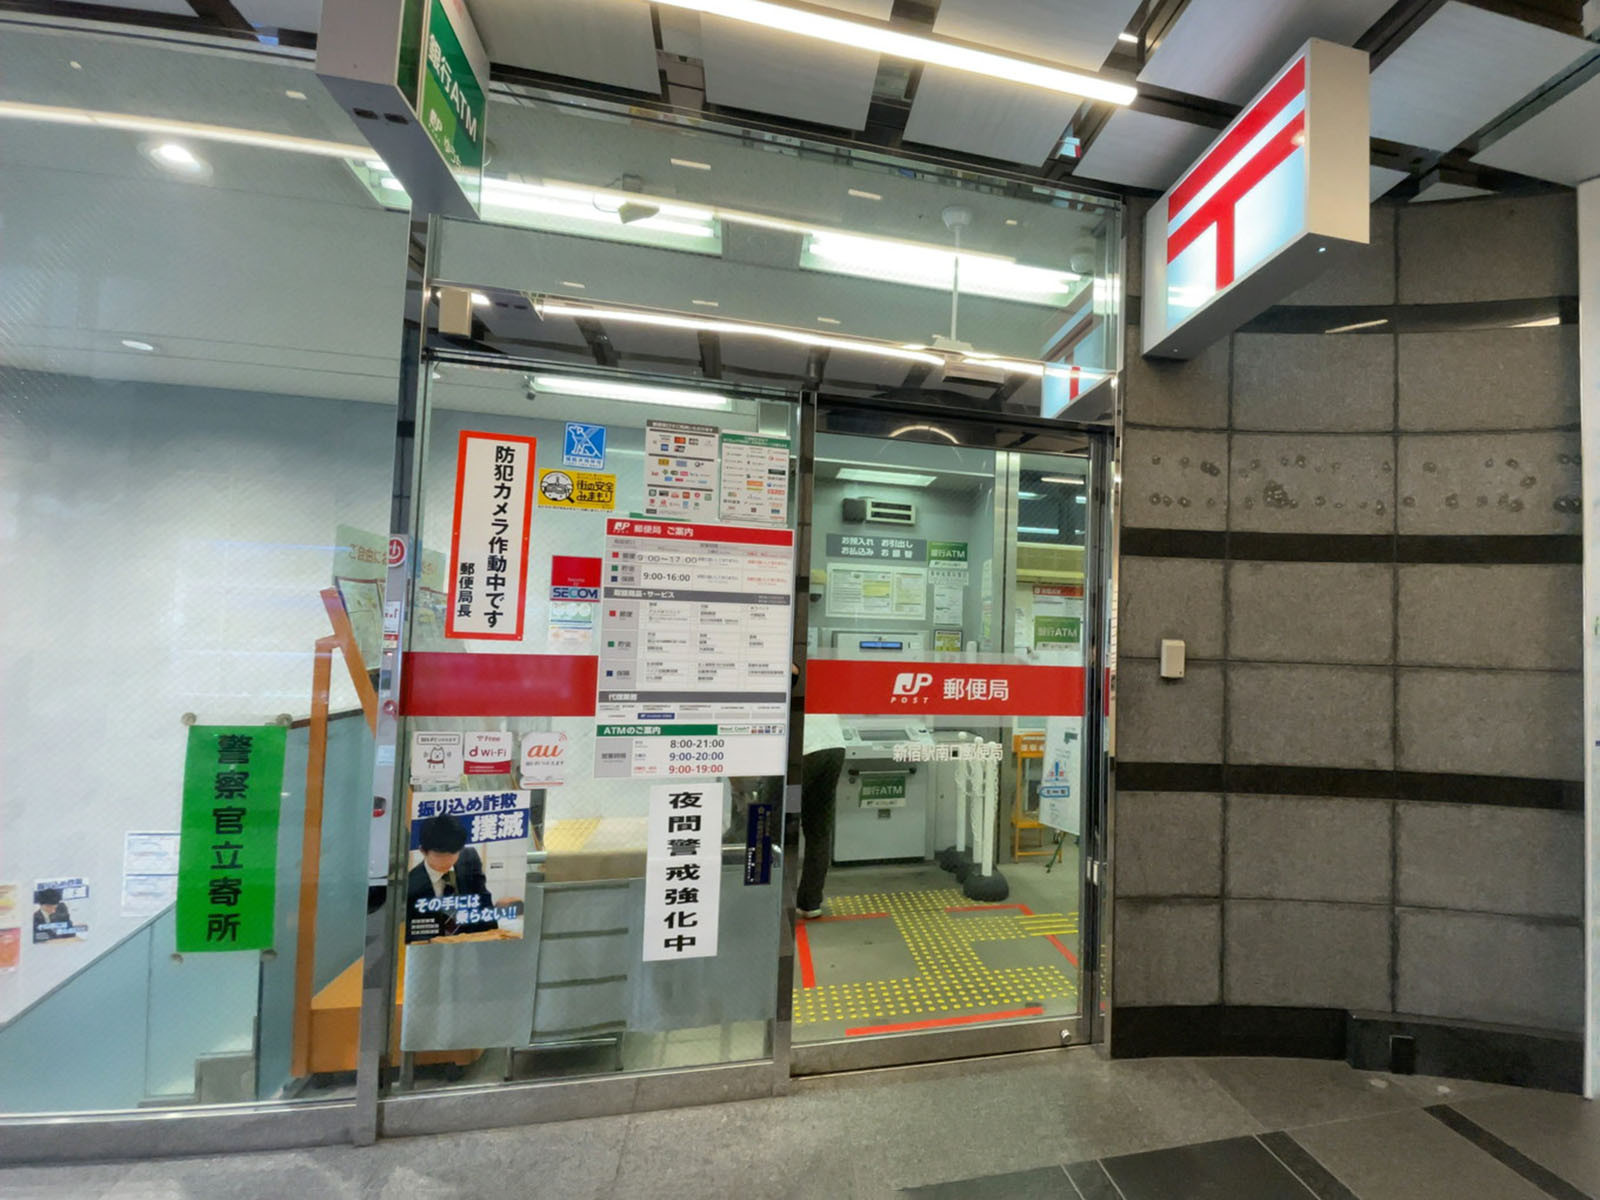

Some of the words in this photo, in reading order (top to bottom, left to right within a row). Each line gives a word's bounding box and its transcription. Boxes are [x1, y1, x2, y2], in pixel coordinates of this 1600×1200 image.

[428, 33, 477, 143] 銀行ATM
[484, 445, 516, 628] 防犯カメラ作動中です
[633, 524, 662, 535] 郵便局
[666, 526, 694, 537] ご案内
[881, 538, 914, 548] お引出し
[643, 571, 691, 582] 9:00-16:00
[457, 562, 475, 618] 郵便局長
[552, 587, 598, 599] SECOM
[893, 672, 933, 696] JP
[943, 677, 1009, 702] 郵便局
[603, 725, 662, 736] ATMのご案内
[481, 747, 507, 757] Wi-Fi
[527, 744, 564, 758] au
[670, 739, 725, 749] 8:00-21:00
[892, 742, 1004, 762] 新宿駅南口郵便局
[669, 751, 725, 761] 9:00-20:00
[668, 763, 724, 774] 9:00-19:00
[417, 792, 518, 818] 振り込め詐欺
[471, 811, 524, 843] 撲滅
[206, 734, 253, 943] 警察官立寄所
[664, 791, 704, 952] 夜間警戒強化中
[414, 894, 481, 913] その手には
